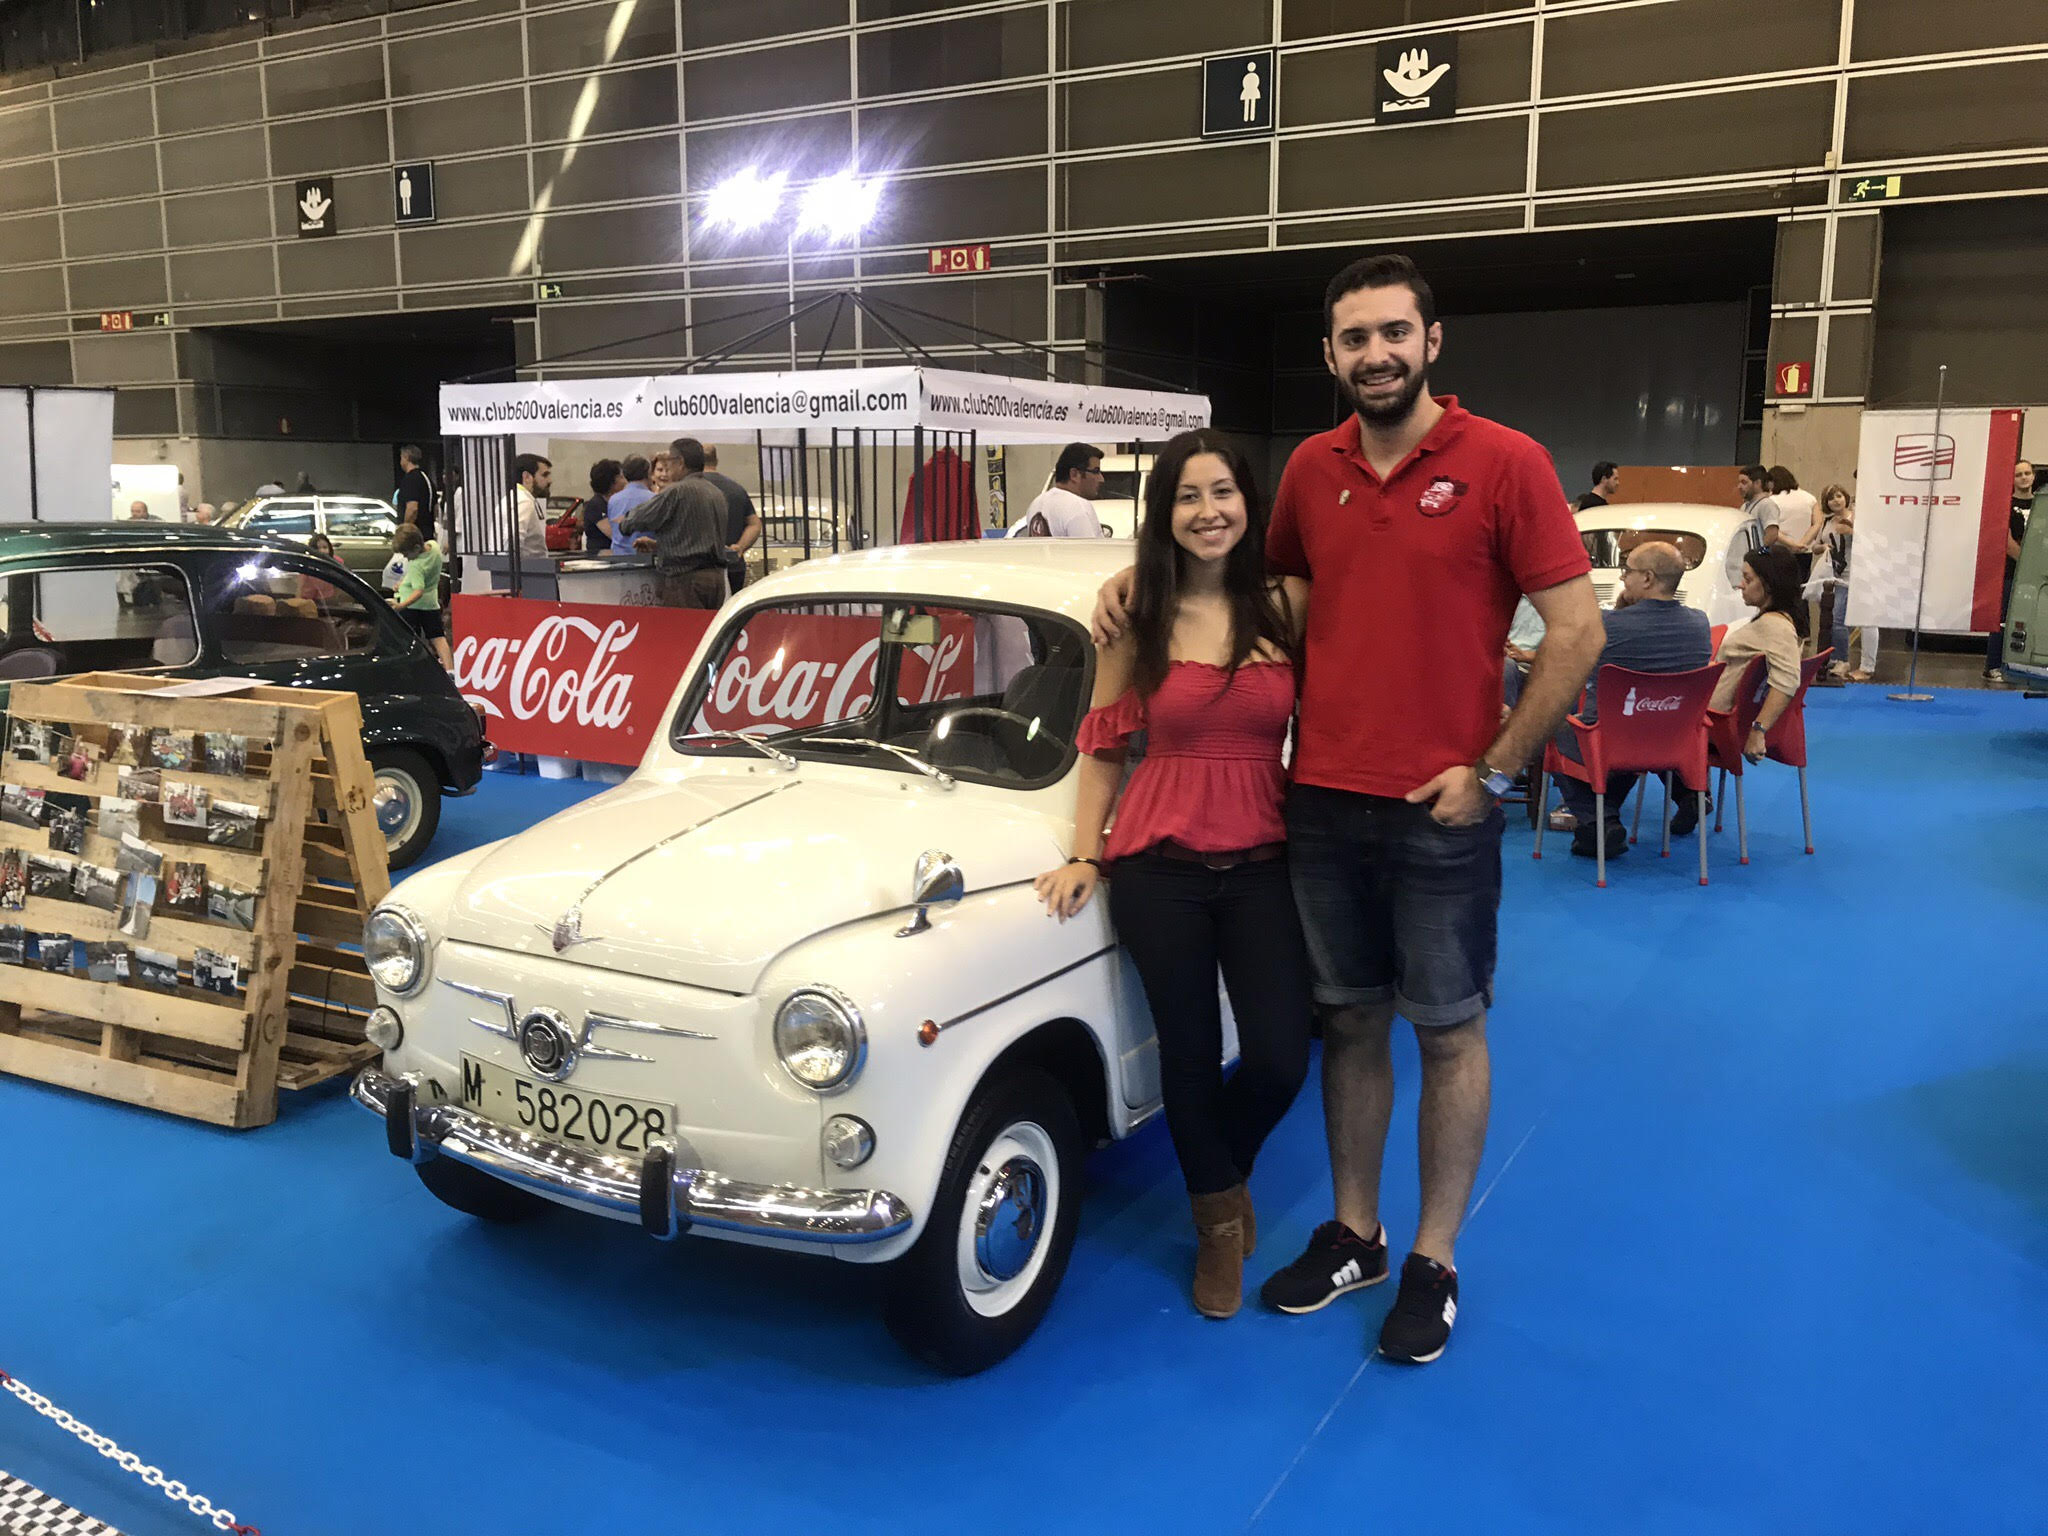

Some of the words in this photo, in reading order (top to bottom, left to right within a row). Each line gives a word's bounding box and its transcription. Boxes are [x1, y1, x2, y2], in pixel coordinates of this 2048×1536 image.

[448, 399, 623, 422] www.club600valencia.es
[654, 389, 907, 418] club600valencia@gmail.com
[930, 392, 1069, 422] www.club600valencia.es
[1086, 404, 1203, 431] club600valencia@gmail.com
[515, 1079, 666, 1152] 582028
